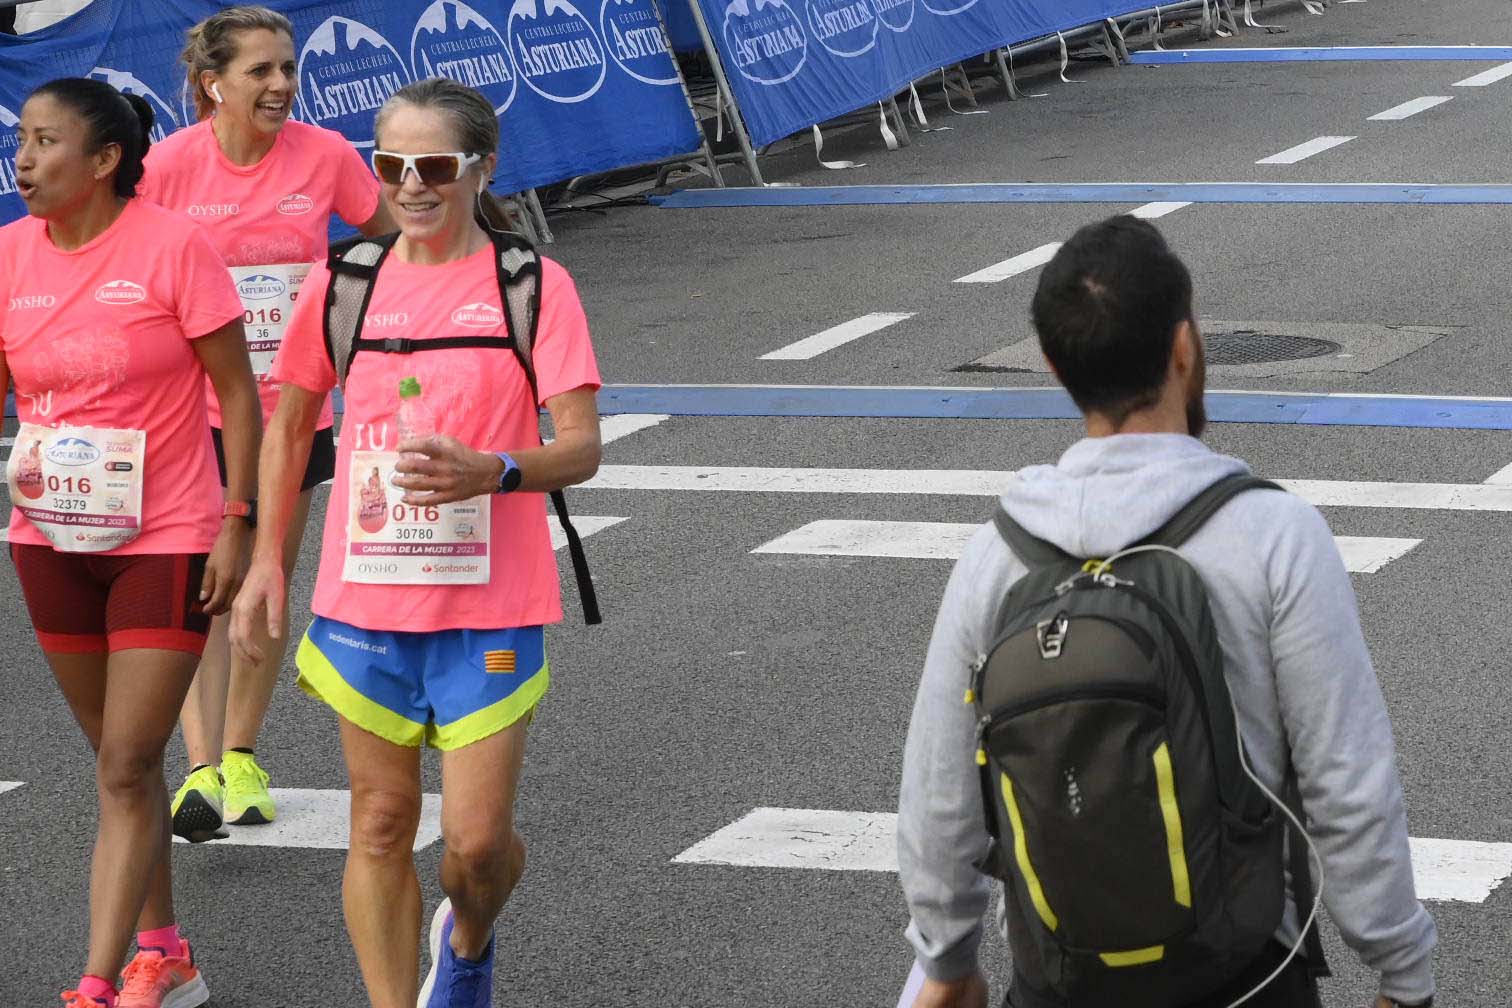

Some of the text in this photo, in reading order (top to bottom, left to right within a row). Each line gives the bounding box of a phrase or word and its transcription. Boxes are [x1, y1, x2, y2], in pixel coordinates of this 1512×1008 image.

[524, 21, 584, 39] CENTRAL LECHERA
[431, 35, 498, 55] CENTRAL LECHERA
[612, 17, 669, 62] ASTUR
[520, 35, 602, 78] ASTURIANA
[318, 54, 393, 78] CENTRAL LECHERA
[308, 70, 403, 122] ASTURIANA
[187, 204, 240, 217] OYSHO
[364, 312, 409, 328] YSHO
[256, 329, 270, 339] 36
[250, 342, 261, 350] DE
[47, 474, 92, 494] 016
[53, 497, 87, 511] 32379
[55, 515, 65, 523] DE
[66, 515, 77, 524] LA
[78, 516, 105, 525] MUJER
[392, 503, 440, 523] 016
[396, 528, 433, 540] 30780
[362, 545, 398, 553] CARRERA
[399, 545, 411, 553] DE
[412, 545, 423, 553] LA
[424, 545, 454, 553] MUJER
[358, 563, 399, 575] OYSHO
[433, 563, 479, 574] Santander
